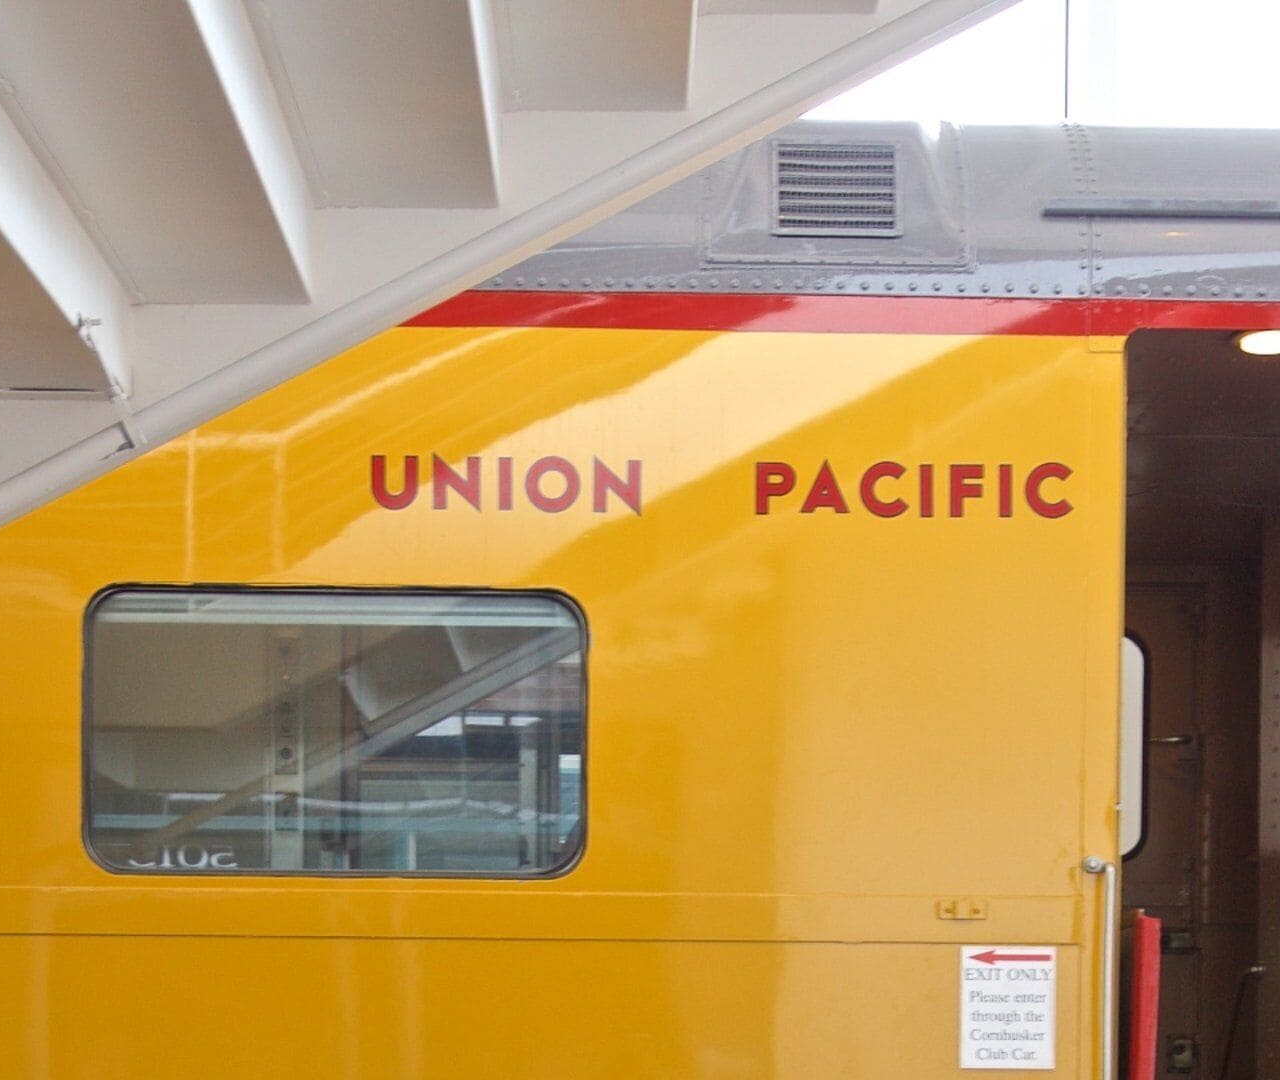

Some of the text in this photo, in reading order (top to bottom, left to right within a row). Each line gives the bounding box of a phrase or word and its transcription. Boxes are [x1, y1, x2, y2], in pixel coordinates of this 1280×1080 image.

[370, 452, 1074, 519] UNION PACIFIC
[964, 968, 1052, 981] EXIT ONLY
[969, 991, 1047, 1004] Please enter
[970, 1010, 1045, 1026] through the
[975, 1047, 1008, 1060] Club
